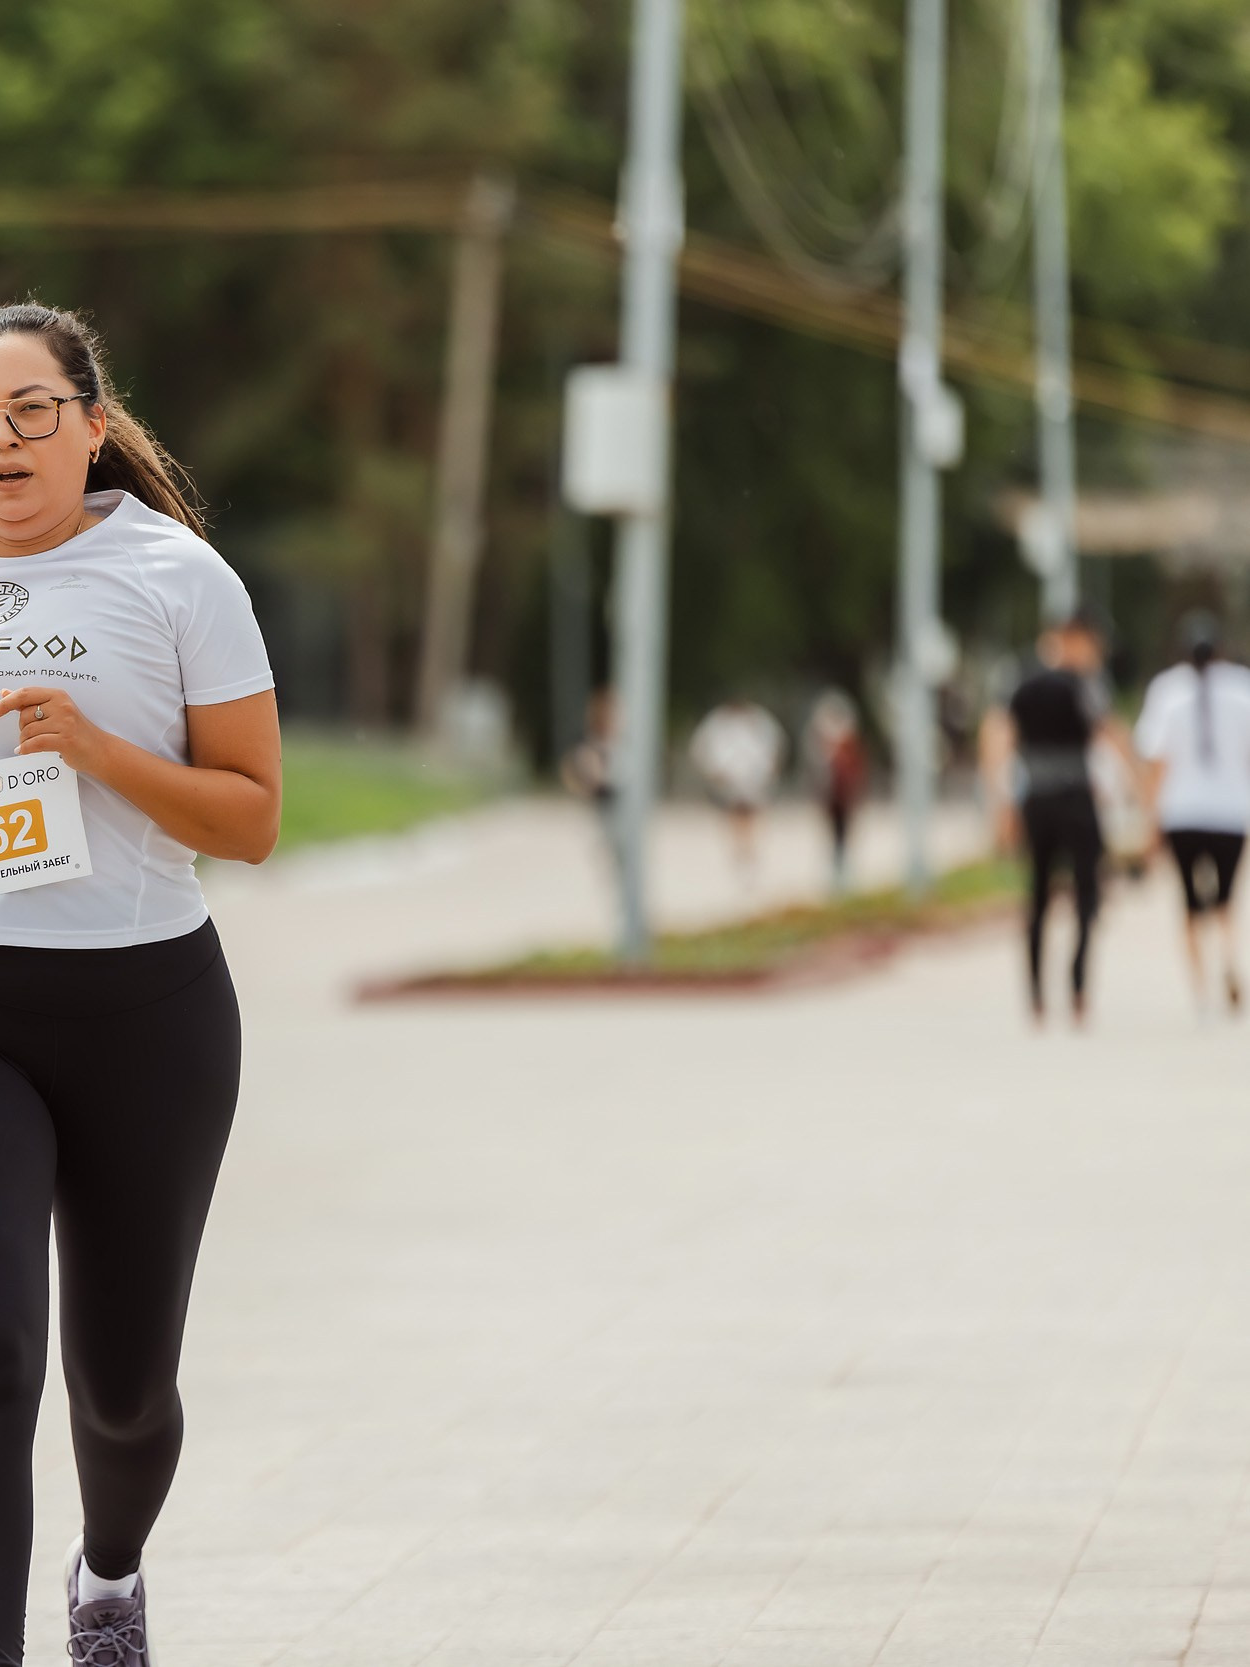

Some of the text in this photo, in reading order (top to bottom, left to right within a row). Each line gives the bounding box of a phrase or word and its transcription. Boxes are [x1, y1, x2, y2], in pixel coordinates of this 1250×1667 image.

[40, 669, 100, 683] продукте.
[8, 766, 60, 790] D'ORO
[42, 855, 71, 869] ЗАБЕГ
